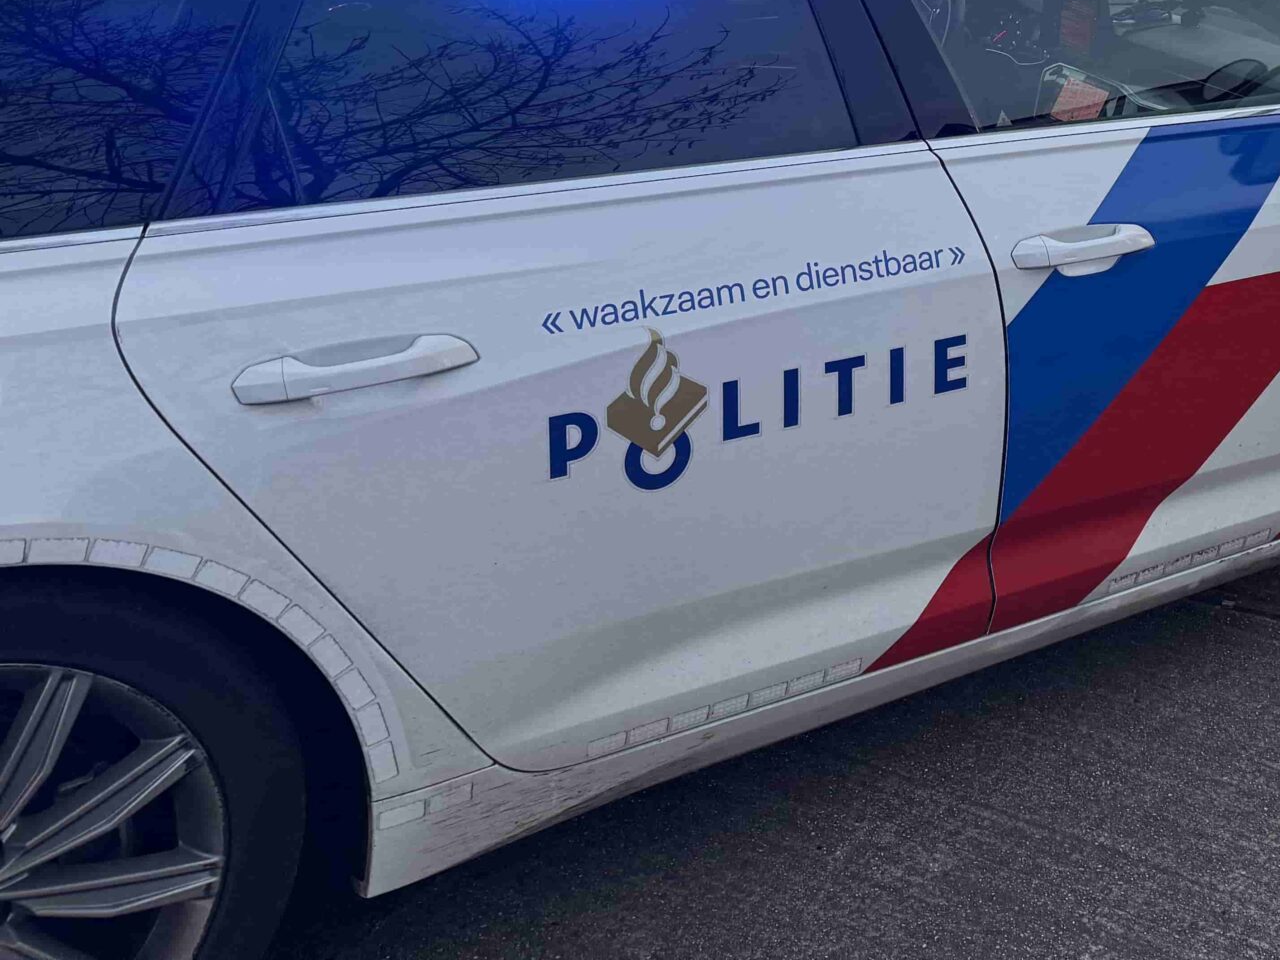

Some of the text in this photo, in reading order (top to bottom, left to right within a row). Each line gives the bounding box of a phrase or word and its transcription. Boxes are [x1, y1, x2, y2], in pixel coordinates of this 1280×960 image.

[569, 282, 746, 330] waakzaam
[752, 275, 790, 299] en
[796, 247, 944, 292] dienstbaar
[548, 333, 968, 491] POLITIE
